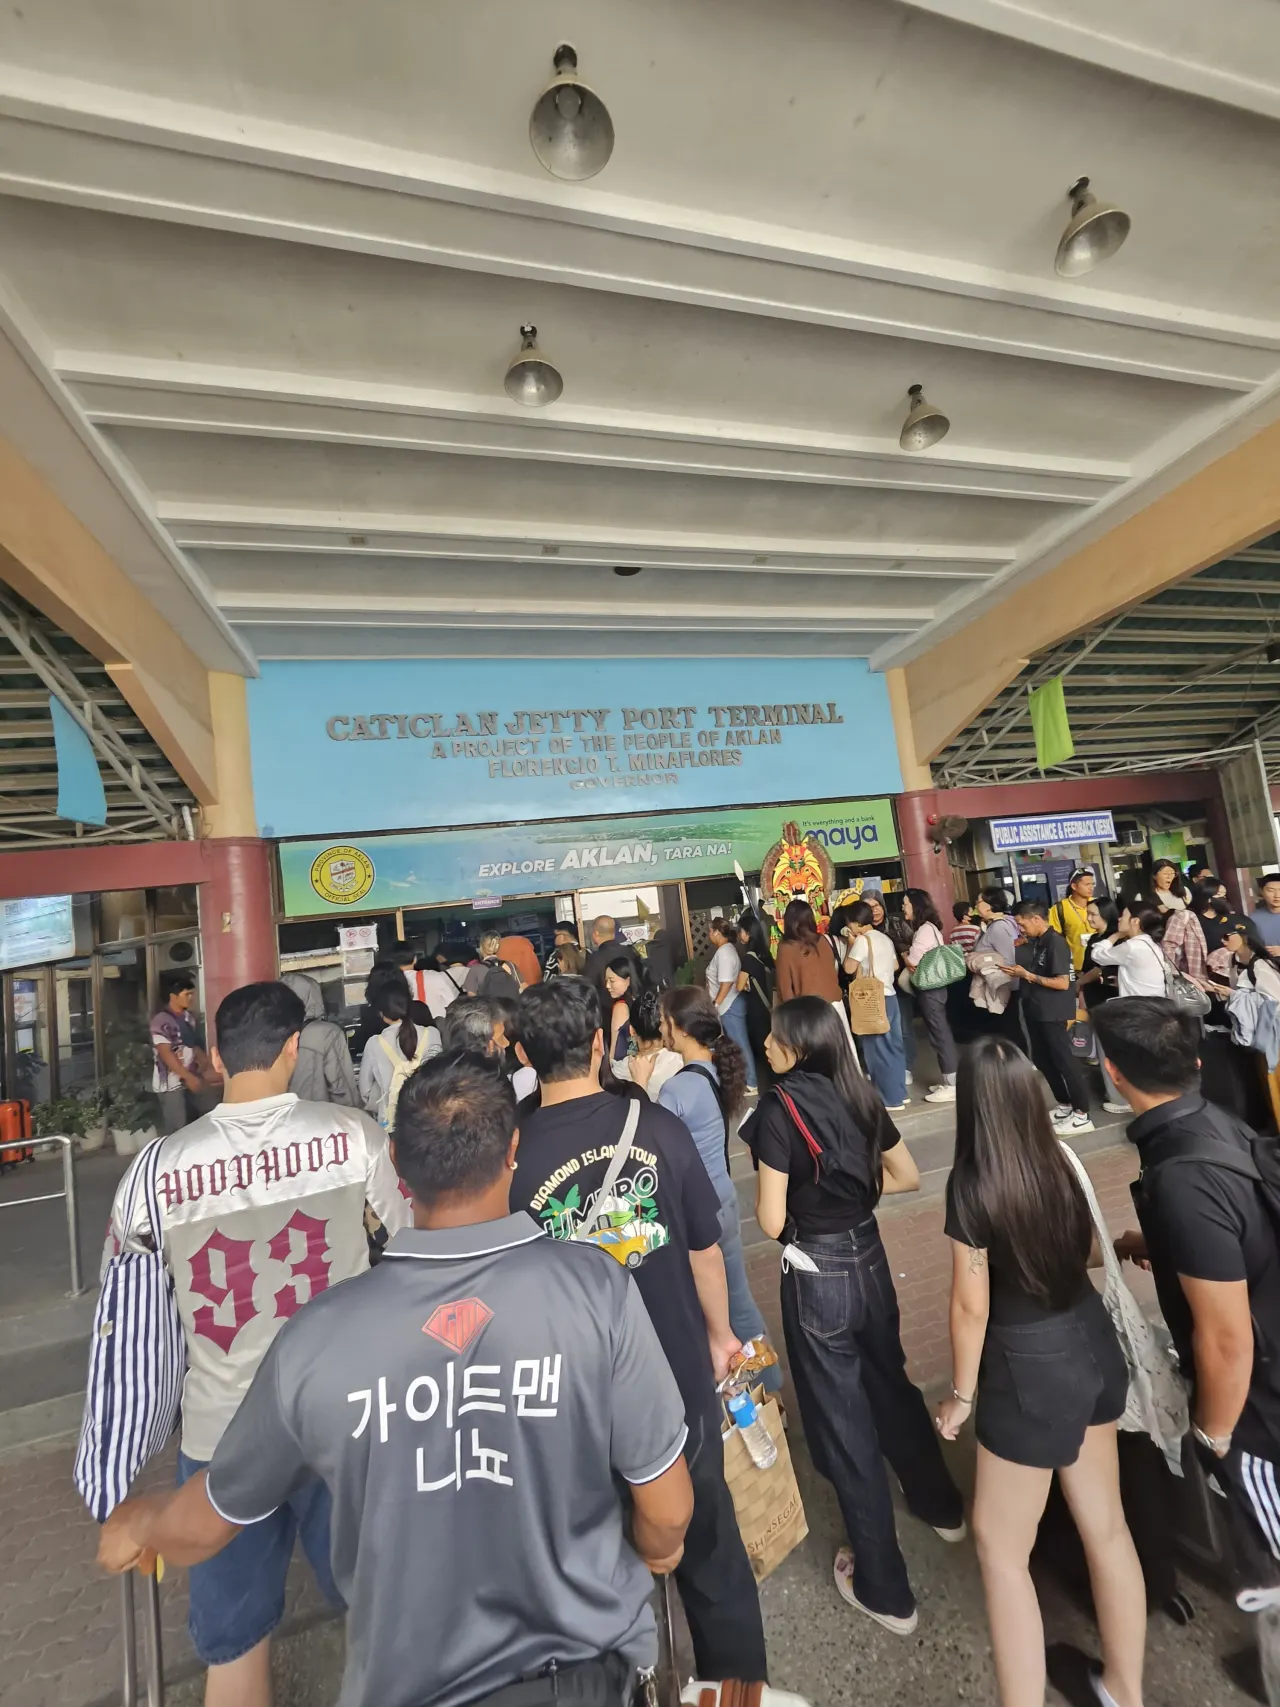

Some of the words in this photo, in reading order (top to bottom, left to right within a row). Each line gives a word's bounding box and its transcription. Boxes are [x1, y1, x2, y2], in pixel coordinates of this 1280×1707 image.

[326, 711, 498, 741] CATICLAN
[504, 708, 610, 736] JETTY
[621, 706, 697, 731] PORT
[708, 702, 844, 729] TERMINAL
[432, 741, 447, 759] A
[452, 737, 540, 758] PROJECT
[549, 736, 573, 754] OF
[581, 734, 616, 753] THE
[623, 731, 693, 752] PEOPLE
[697, 730, 720, 748] OF
[725, 728, 782, 746] AKLAN
[605, 755, 621, 773] T.
[628, 749, 743, 772] MIRAFLORES
[569, 772, 679, 791] GOVERNOR
[805, 824, 878, 850] maya
[812, 818, 843, 827] everything
[994, 825, 1020, 845] PUBLIC
[1019, 822, 1060, 843] ASSISTANCE
[1063, 819, 1097, 839] FEEDBACK
[1095, 818, 1113, 836] DESK
[314, 848, 341, 872] PROVINCE
[354, 851, 371, 869] AKLAN
[478, 858, 556, 878] EXPLORE
[560, 842, 659, 870] AKLAN,
[663, 846, 702, 861] TARA
[706, 842, 733, 857] NA!
[324, 892, 351, 902] OFFICIAL
[352, 889, 367, 899] SEAL
[155, 1131, 350, 1215] HOODHOOD
[530, 1158, 581, 1211] DIAMOND
[580, 1144, 619, 1167] ISLAN
[629, 1145, 658, 1171] TOUR
[347, 1353, 562, 1443] 가이드맨
[416, 1427, 514, 1492] 니뇨
